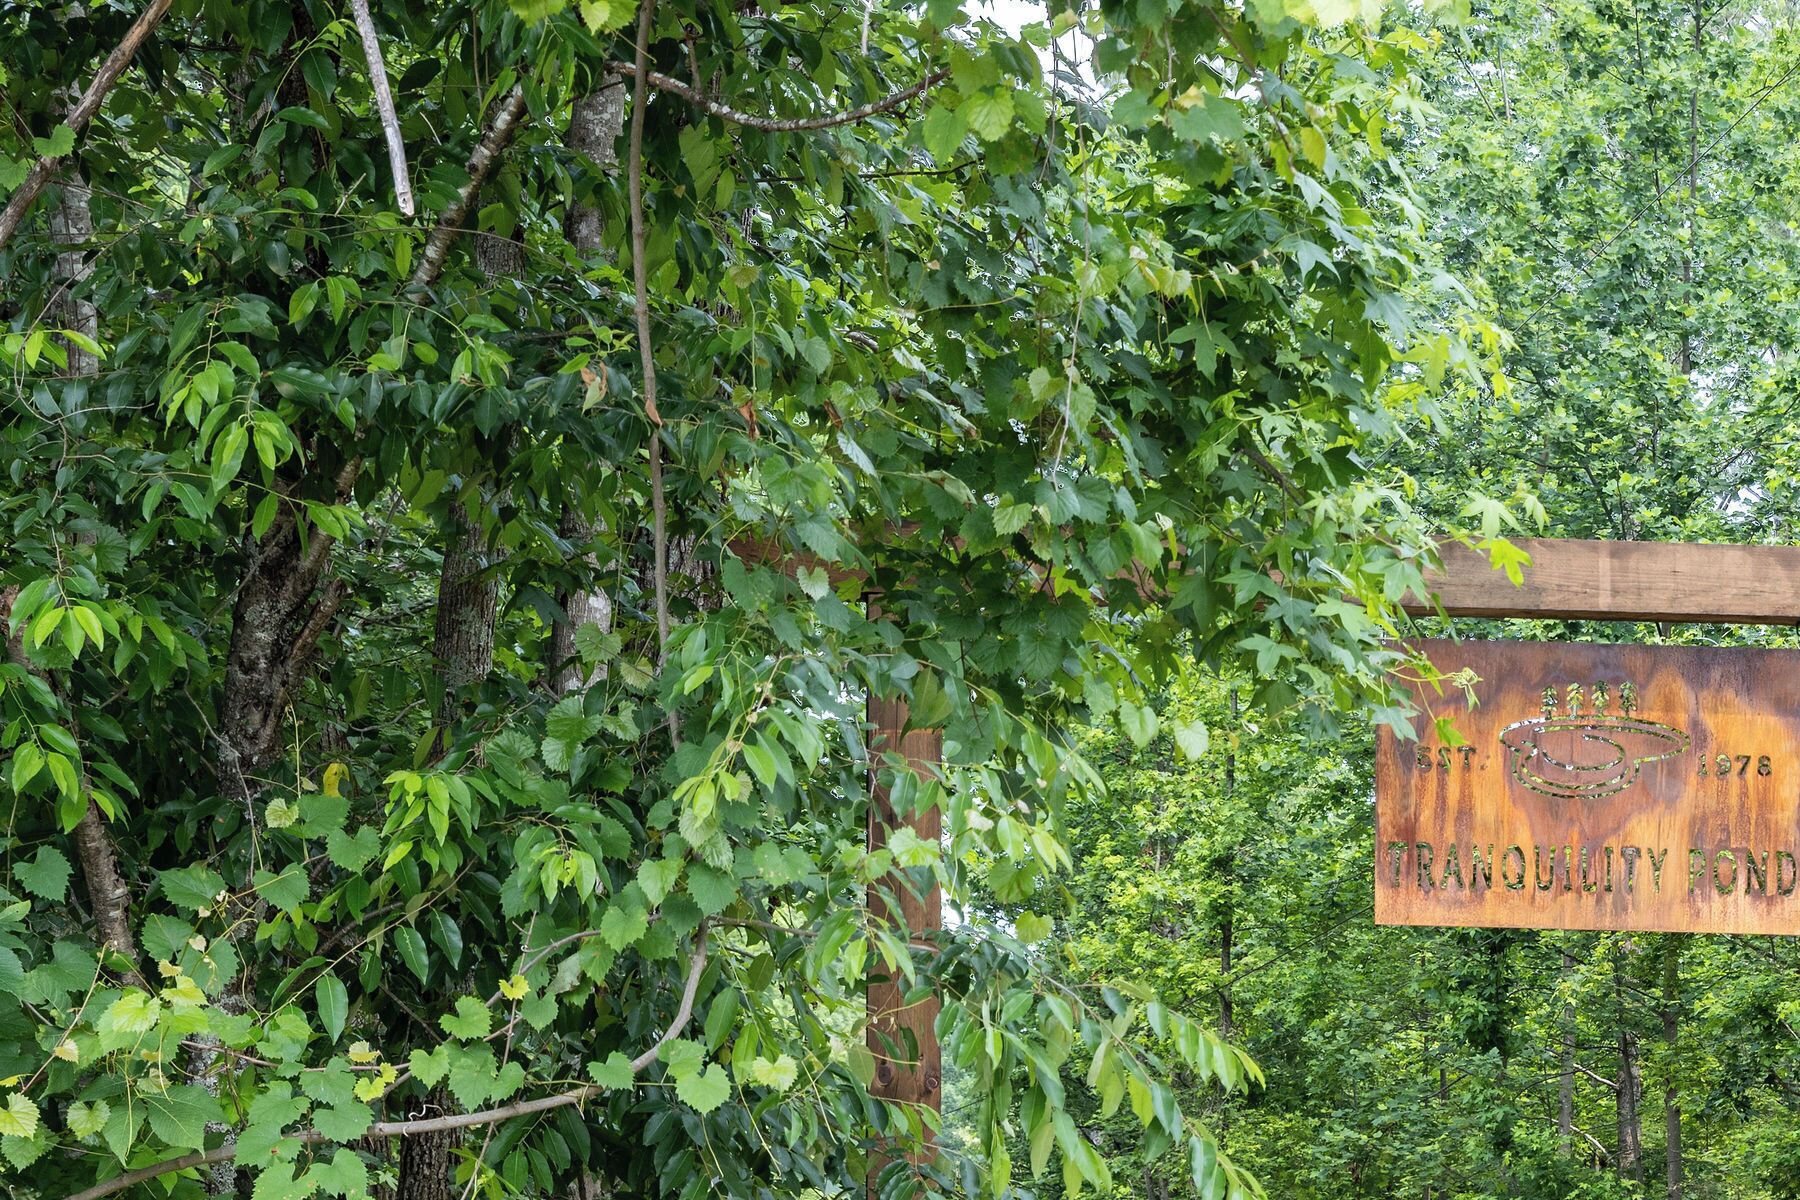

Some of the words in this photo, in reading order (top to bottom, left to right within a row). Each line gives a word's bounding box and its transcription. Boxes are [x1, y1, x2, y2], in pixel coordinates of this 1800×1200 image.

[1699, 754, 1773, 777] 1978
[1387, 841, 1668, 893] TRANQUILITY
[1689, 848, 1798, 897] POND
